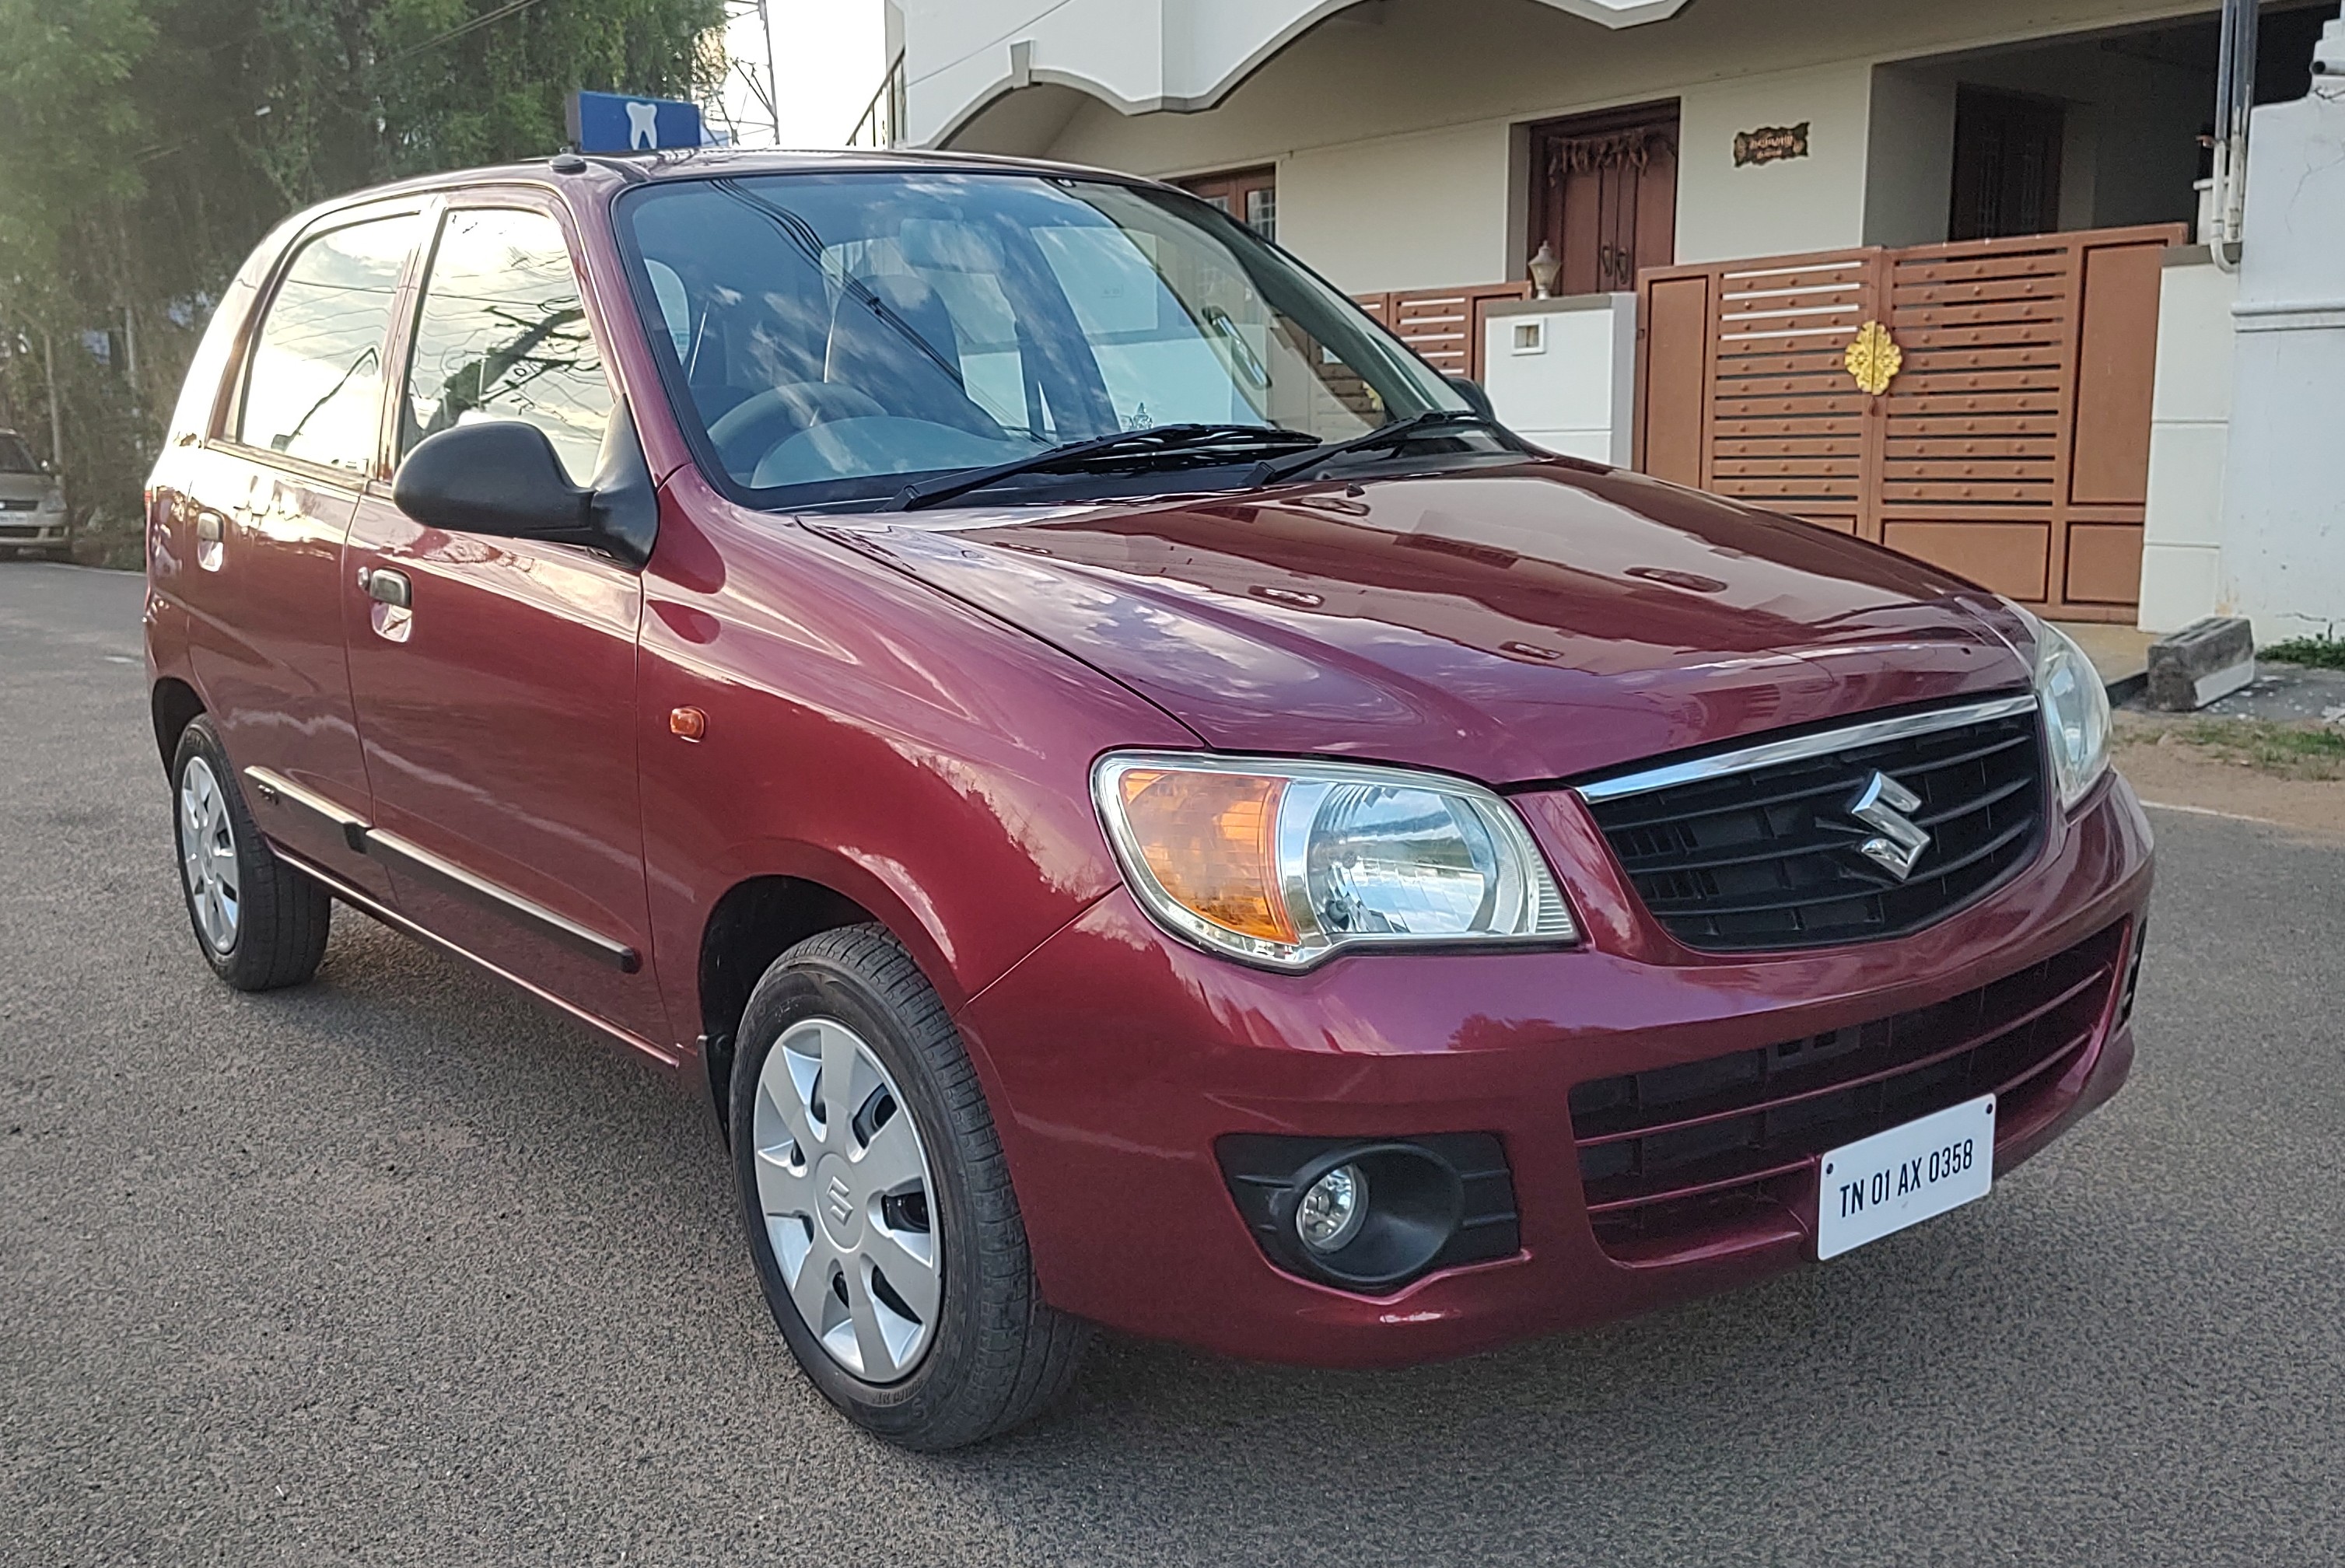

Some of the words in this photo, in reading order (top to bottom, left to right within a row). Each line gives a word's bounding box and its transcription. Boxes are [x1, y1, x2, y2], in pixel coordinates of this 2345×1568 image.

[1839, 1178, 1864, 1218] TN
[1871, 1169, 1890, 1206] 01
[1897, 1157, 1923, 1197] AX
[1928, 1138, 1973, 1183] 0358
